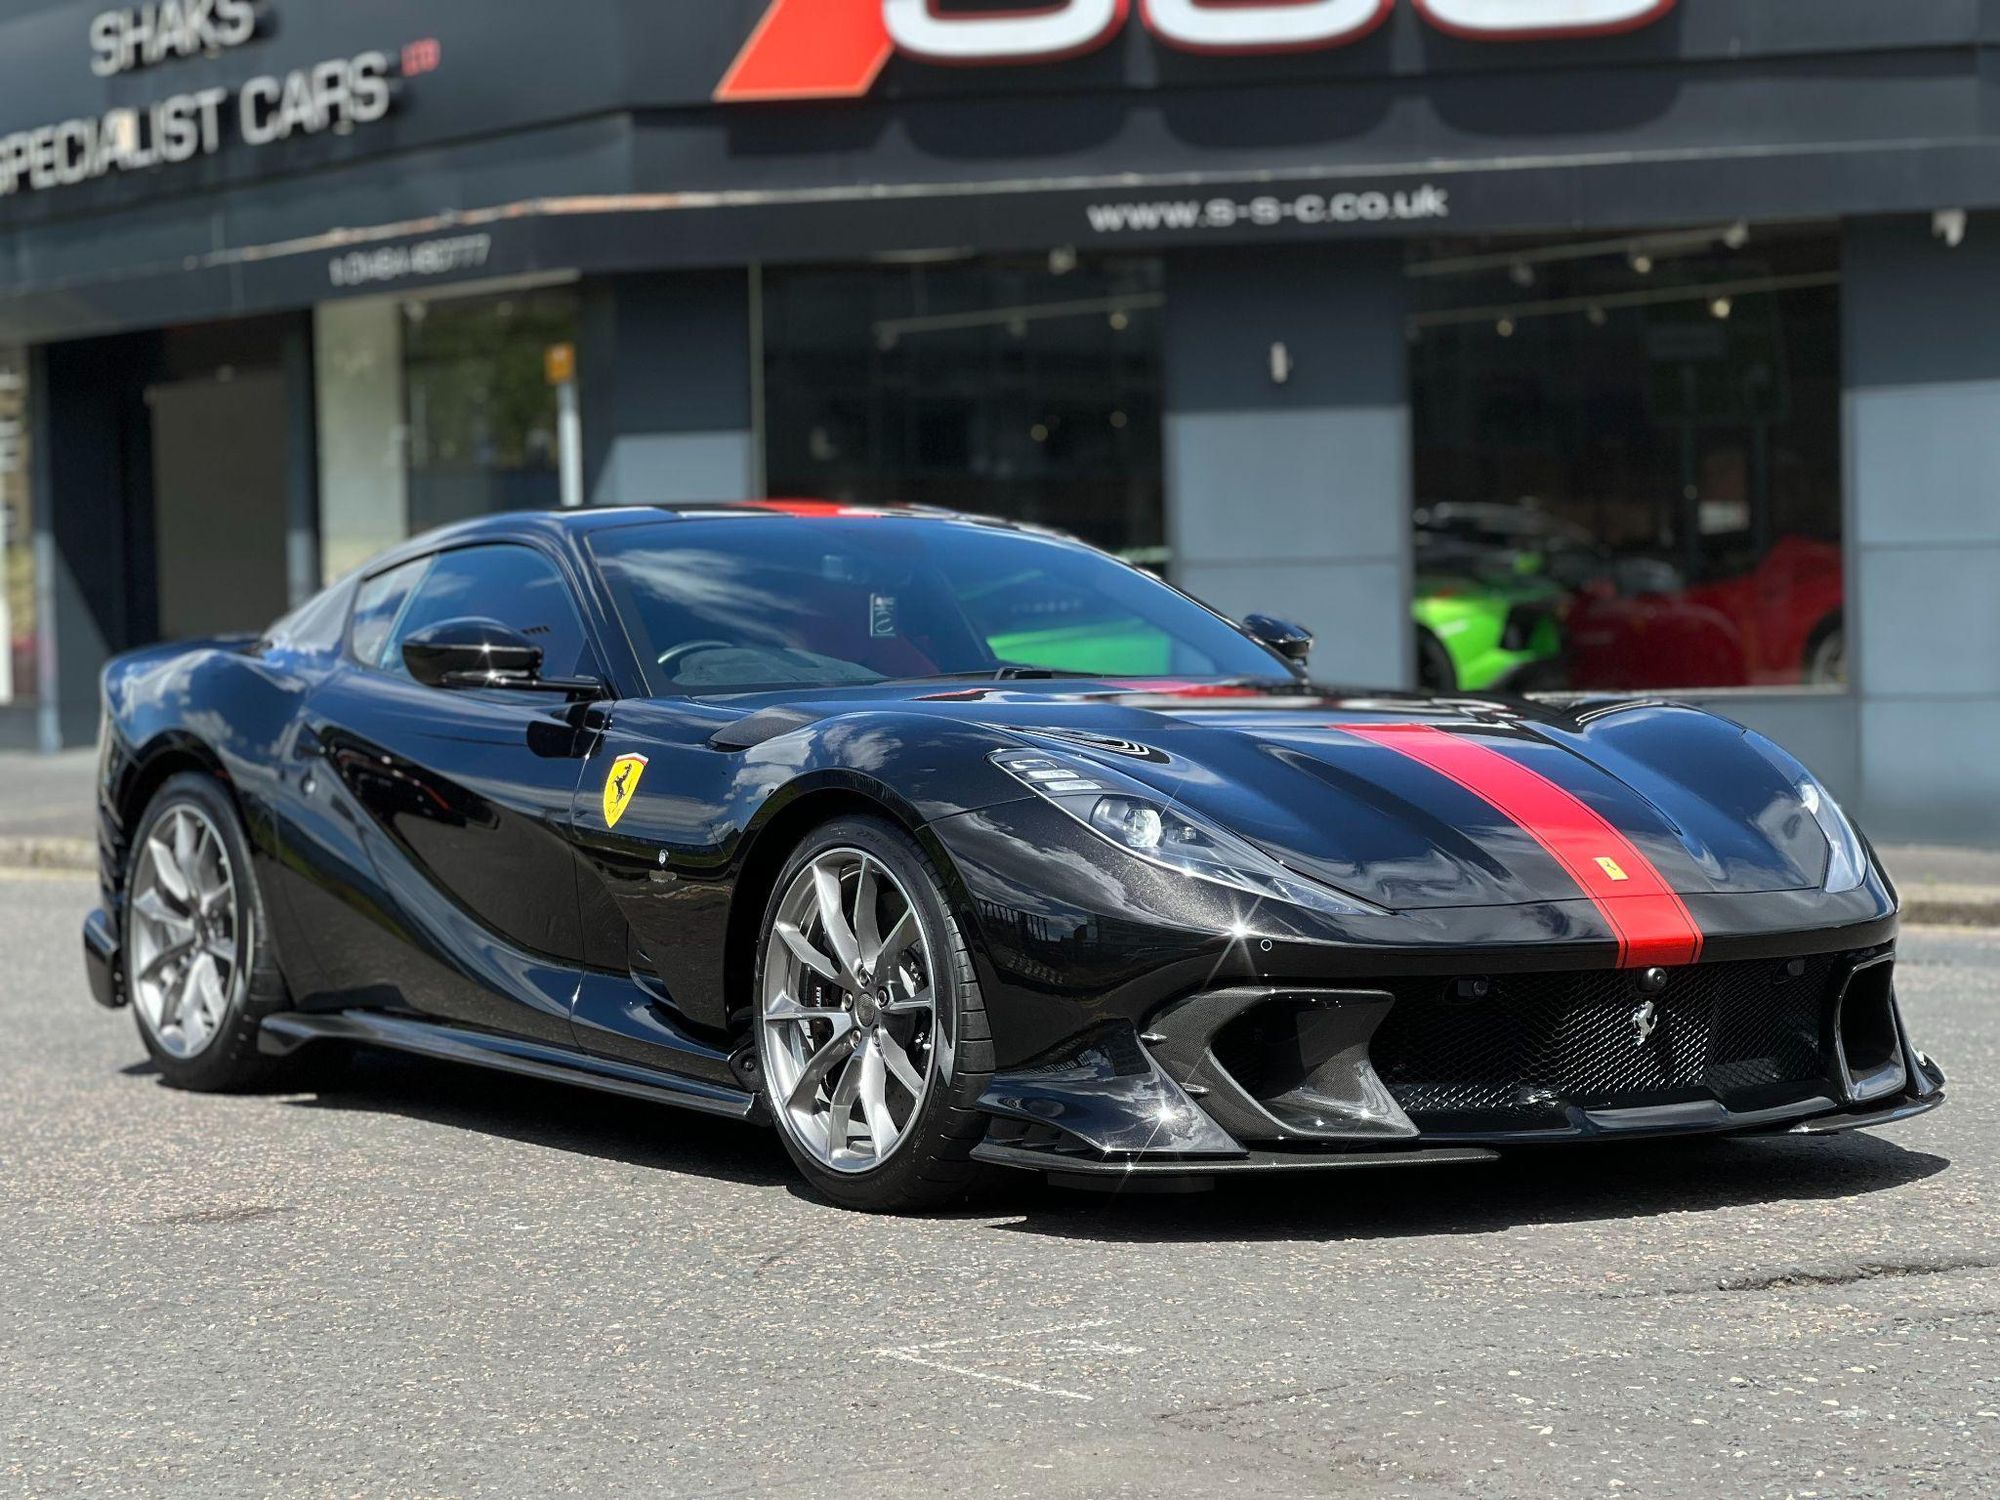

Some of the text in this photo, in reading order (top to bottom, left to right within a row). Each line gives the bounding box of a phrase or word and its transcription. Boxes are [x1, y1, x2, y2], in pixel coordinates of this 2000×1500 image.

[89, 0, 255, 77] SHAKS
[0, 86, 228, 196] PECIALIST
[239, 50, 390, 146] CARS
[1086, 183, 1449, 232] www.s-s-c.co.uk
